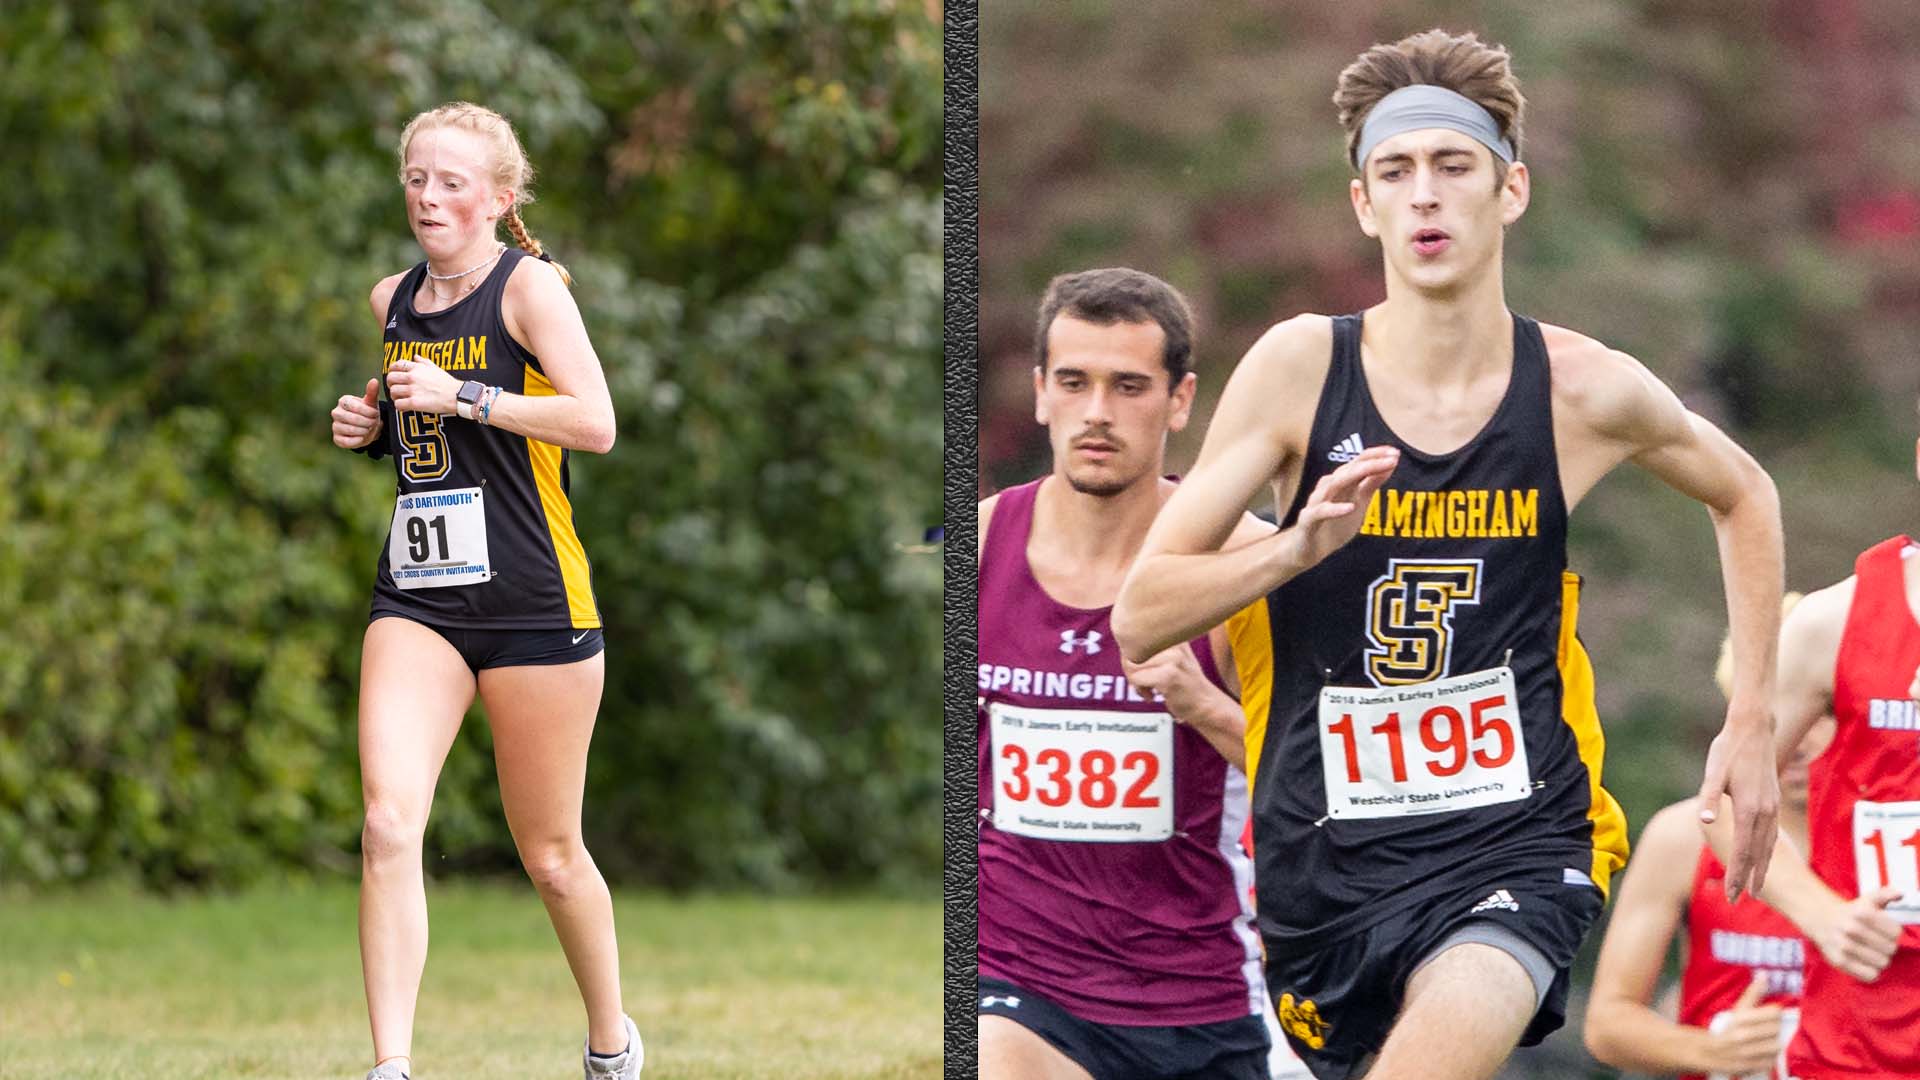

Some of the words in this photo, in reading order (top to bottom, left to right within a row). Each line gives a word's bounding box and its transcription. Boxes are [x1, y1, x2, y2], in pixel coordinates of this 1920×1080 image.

[415, 493, 472, 509] DARTMOUTH
[406, 514, 450, 564] 91
[403, 570, 420, 578] CROSS
[420, 567, 445, 577] COUNTRY
[446, 564, 486, 576] INVITATIONAL
[1358, 696, 1395, 705] James
[1398, 690, 1434, 702] Earley
[1437, 675, 1500, 696] Invitational
[1027, 720, 1061, 731] James
[1096, 722, 1159, 734] Invitational
[1327, 694, 1516, 783] 1195
[1001, 743, 1161, 809] 3382
[1348, 794, 1405, 806] Westfield
[1407, 792, 1441, 804] State
[1443, 782, 1504, 799] University
[1063, 820, 1088, 830] State
[1091, 820, 1142, 833] University
